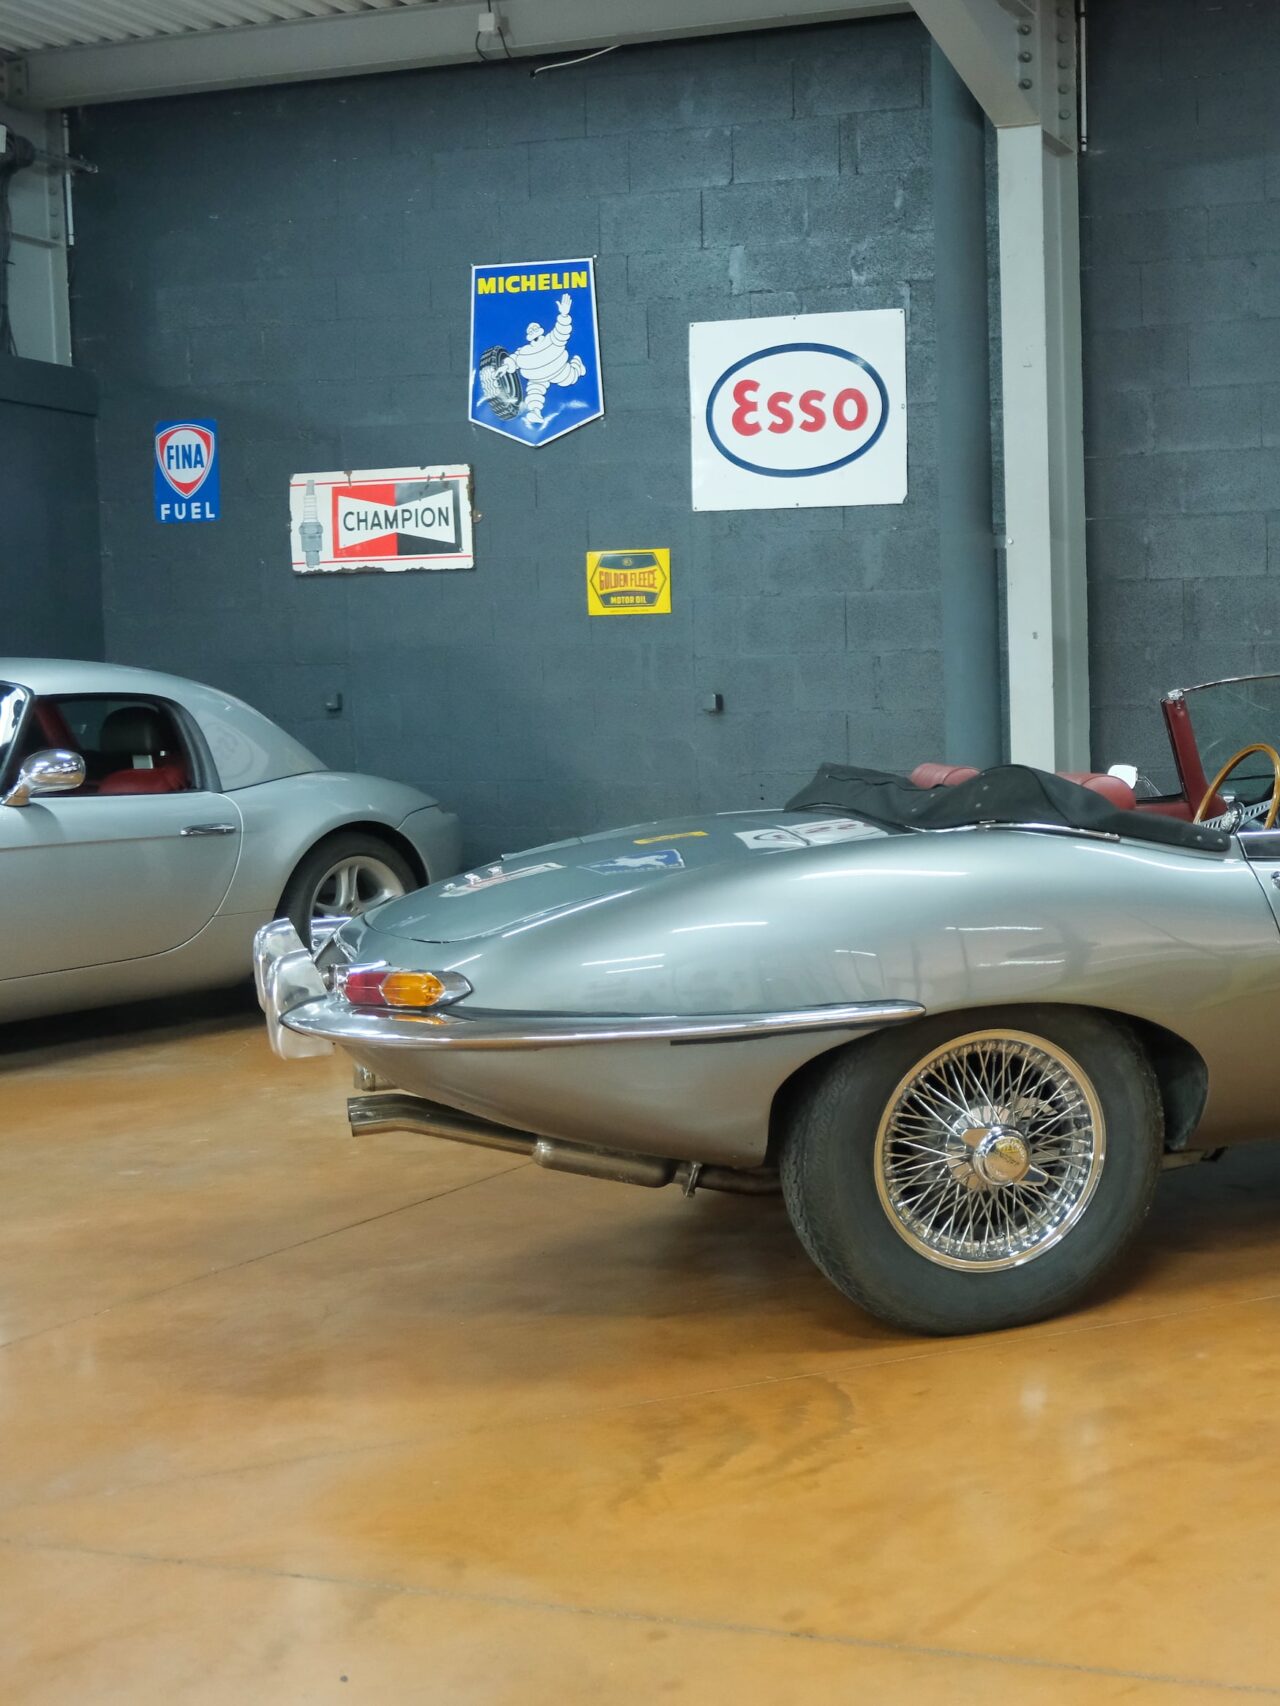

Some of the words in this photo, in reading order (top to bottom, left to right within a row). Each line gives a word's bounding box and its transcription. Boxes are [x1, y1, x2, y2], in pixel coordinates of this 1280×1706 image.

[477, 271, 588, 295] MICHELIN
[166, 443, 205, 470] FINA
[160, 501, 216, 521] FUEL
[343, 506, 450, 532] CHAMPION
[599, 570, 629, 591] GOLDEN
[630, 568, 658, 590] FLEECE
[610, 596, 635, 604] MOTOR
[635, 595, 648, 604] OIL
